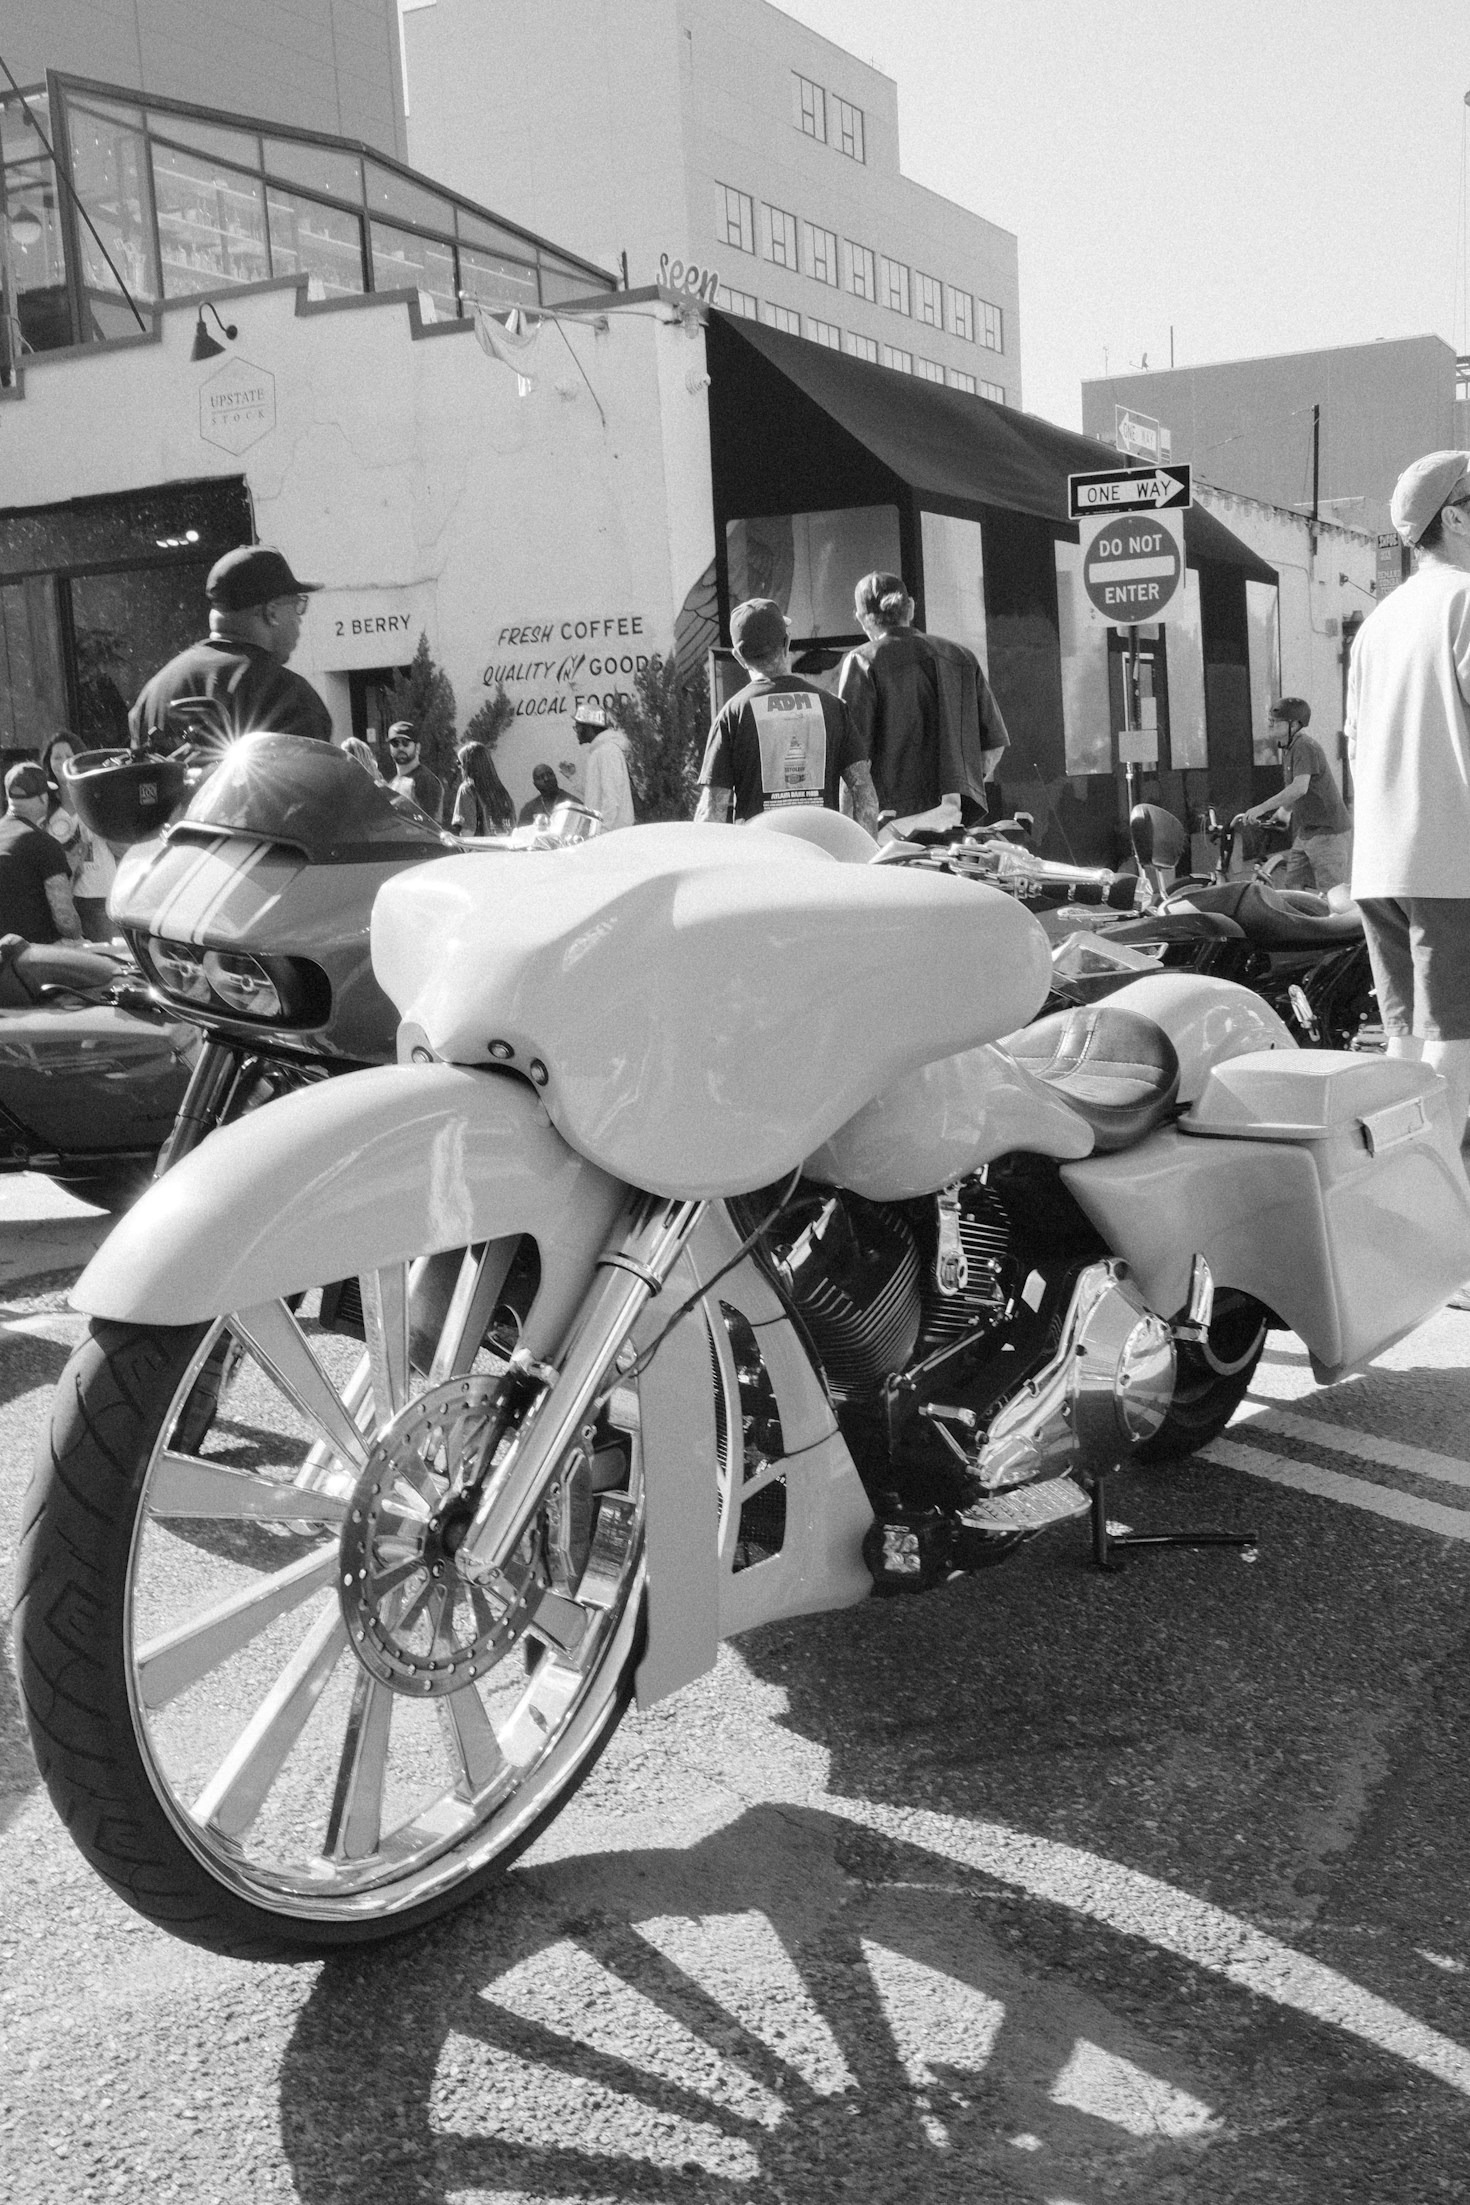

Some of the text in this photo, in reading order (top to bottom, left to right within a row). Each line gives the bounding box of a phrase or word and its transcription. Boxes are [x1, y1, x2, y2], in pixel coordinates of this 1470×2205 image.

[210, 388, 265, 408] UPSTATE
[1087, 480, 1171, 503] ONE WAY
[1100, 534, 1162, 557] DO NOT
[1105, 583, 1159, 604] ENTER
[335, 614, 411, 636] 2 BERRY
[498, 616, 643, 646] FRESH COFFEE
[483, 661, 556, 687] QUALITY
[589, 653, 663, 676] GOODS
[516, 697, 568, 716] LOCAL
[768, 694, 812, 712] ADM
